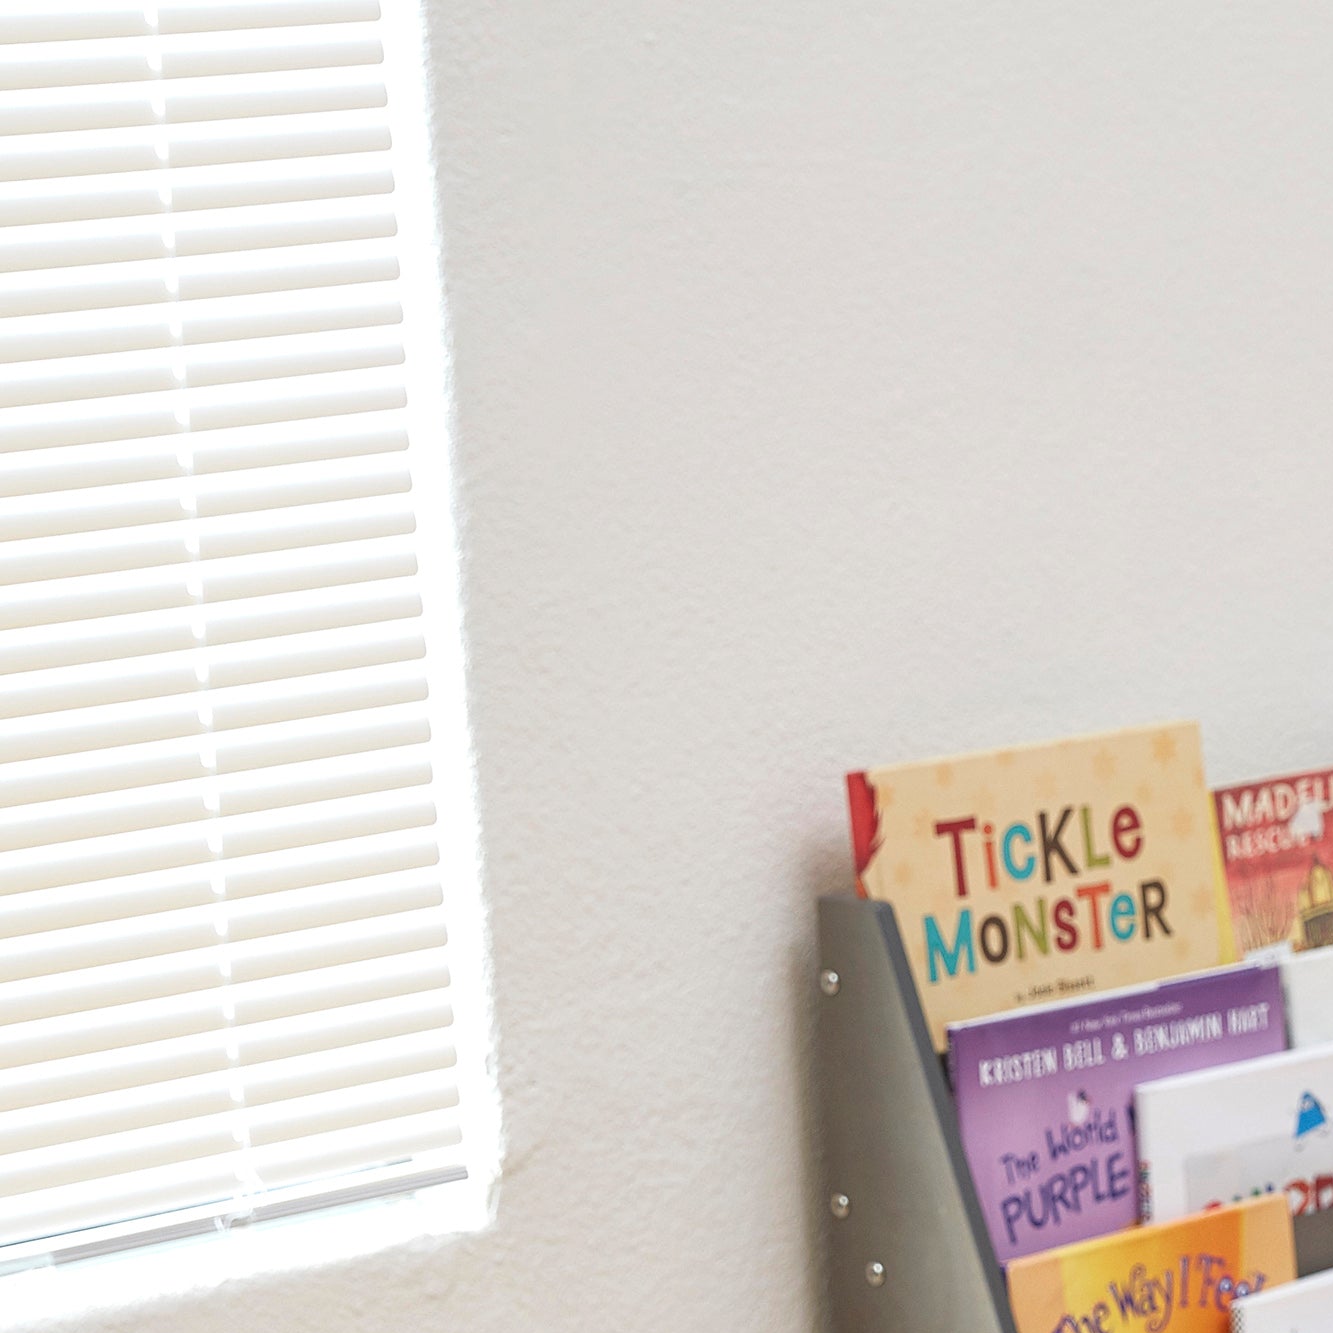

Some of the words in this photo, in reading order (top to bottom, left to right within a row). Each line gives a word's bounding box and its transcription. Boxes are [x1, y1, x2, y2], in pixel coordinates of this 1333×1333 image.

[979, 1046, 1058, 1088] KRISTEN
[1062, 1036, 1105, 1071] BELL
[1111, 1032, 1129, 1061] &
[1133, 1011, 1223, 1057] BENJAMIN
[1045, 1108, 1118, 1160] World
[1001, 1151, 1130, 1246] PURPLE
